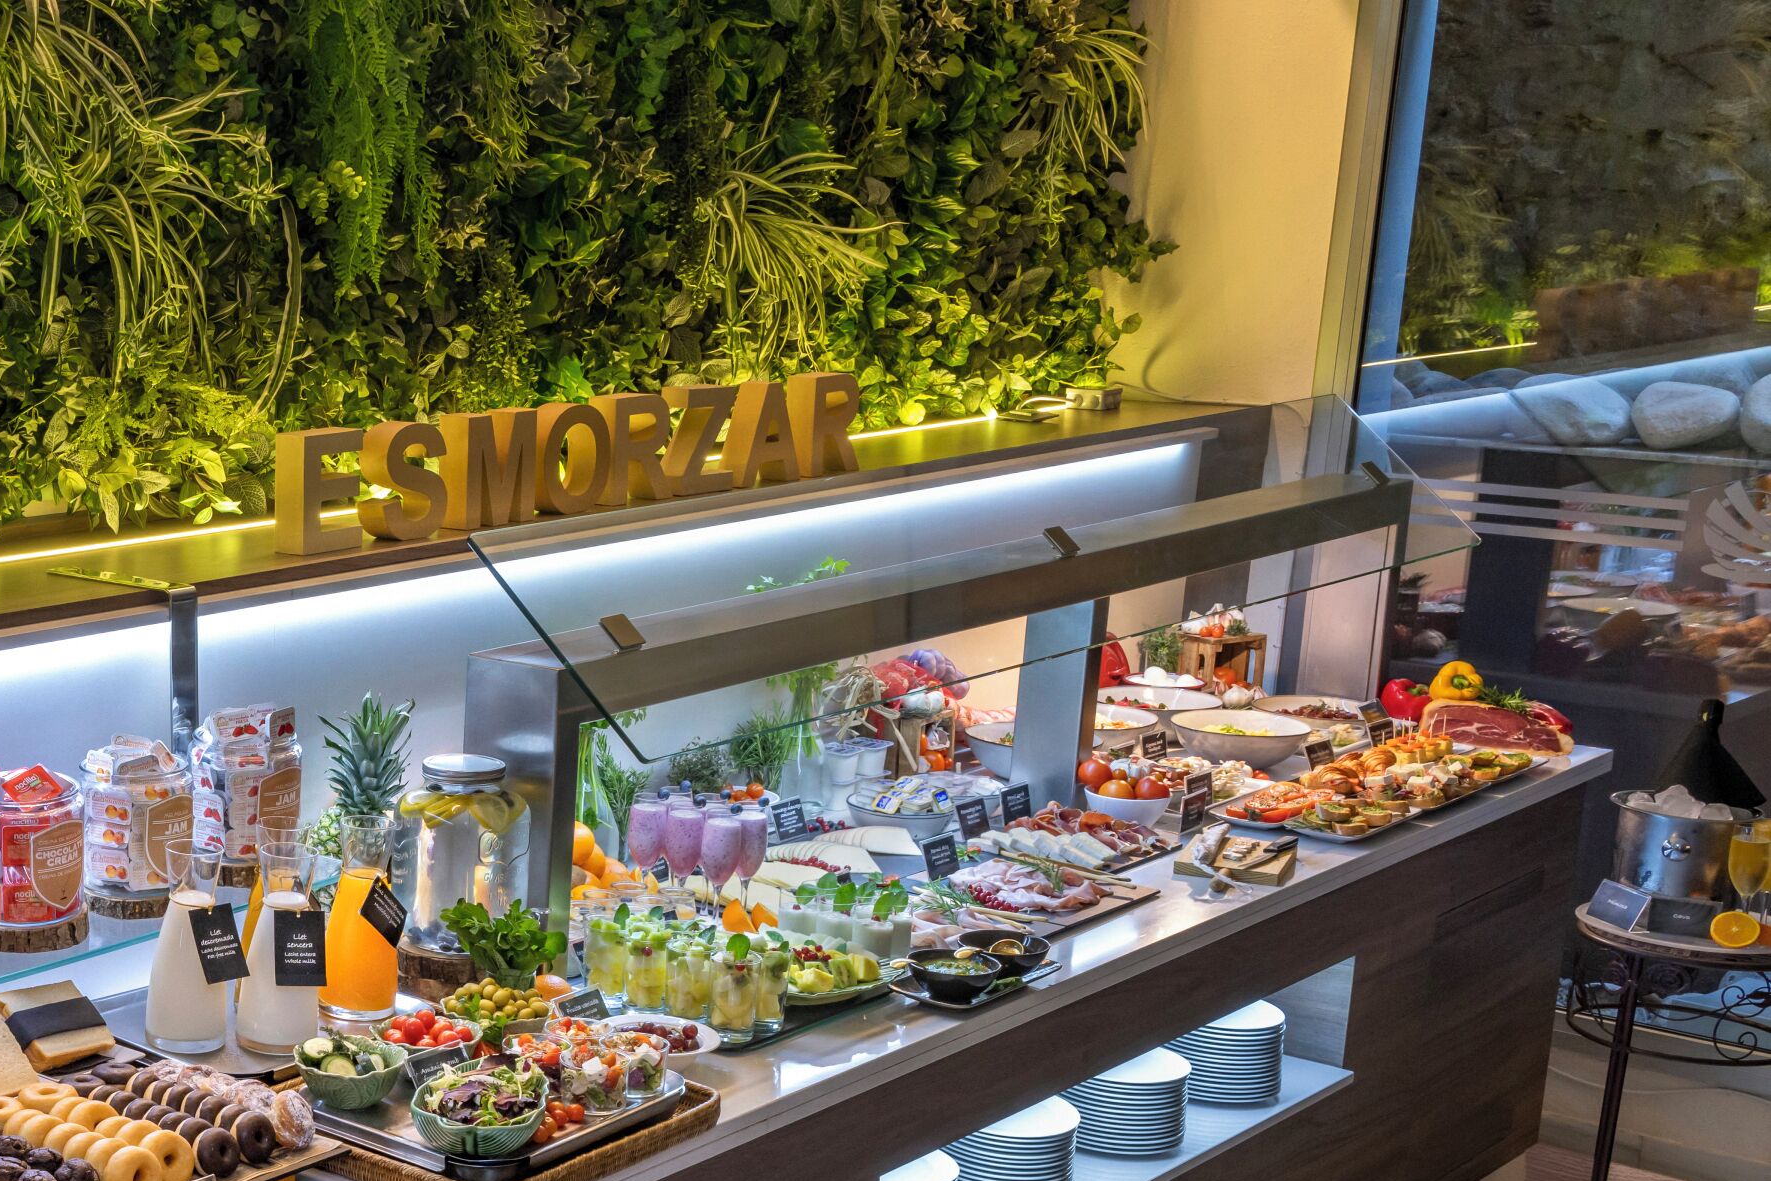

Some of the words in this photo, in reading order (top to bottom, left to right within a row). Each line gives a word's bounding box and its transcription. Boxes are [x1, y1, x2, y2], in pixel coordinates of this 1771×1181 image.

[274, 372, 860, 556] ESMORZAR
[14, 774, 37, 791] nocilla
[276, 794, 296, 806] JAM
[164, 820, 188, 835] JAM
[46, 850, 79, 867] CREAM
